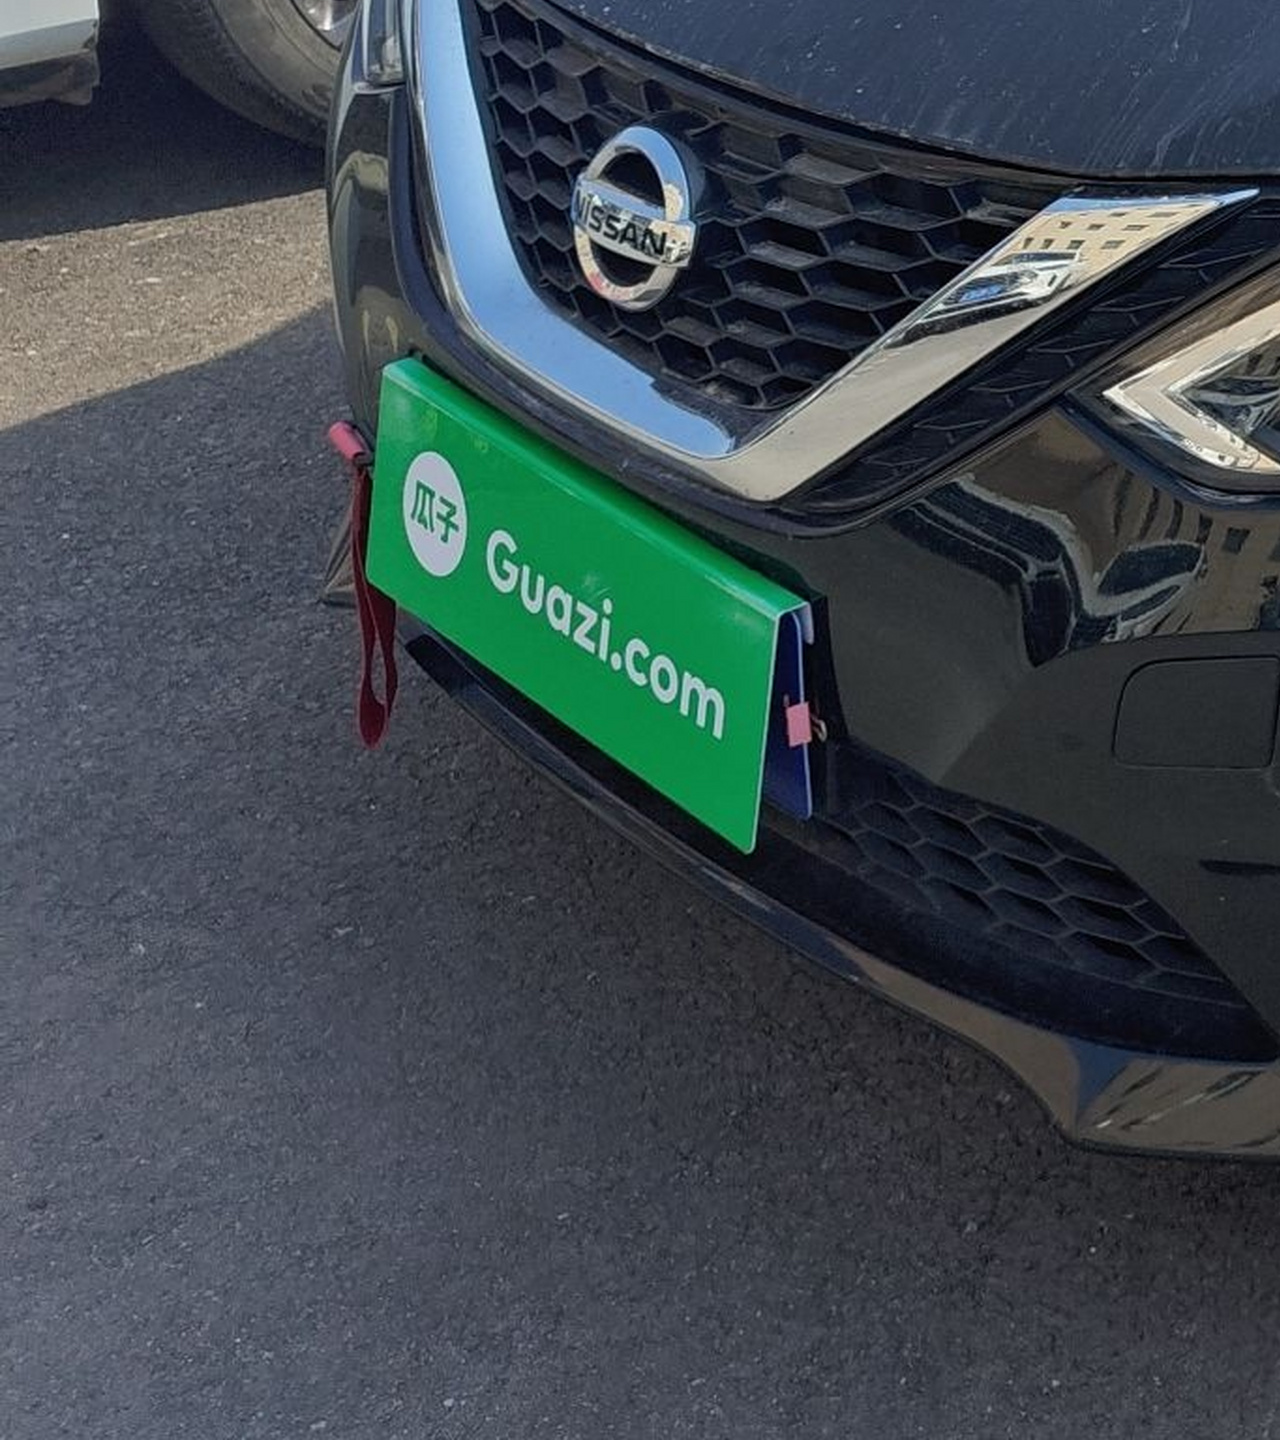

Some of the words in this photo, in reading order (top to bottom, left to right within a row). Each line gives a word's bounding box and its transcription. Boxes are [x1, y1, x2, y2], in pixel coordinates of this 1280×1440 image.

[575, 186, 668, 257] NISSAN
[410, 480, 460, 543] 瓜子
[485, 529, 726, 741] Guazi.com
